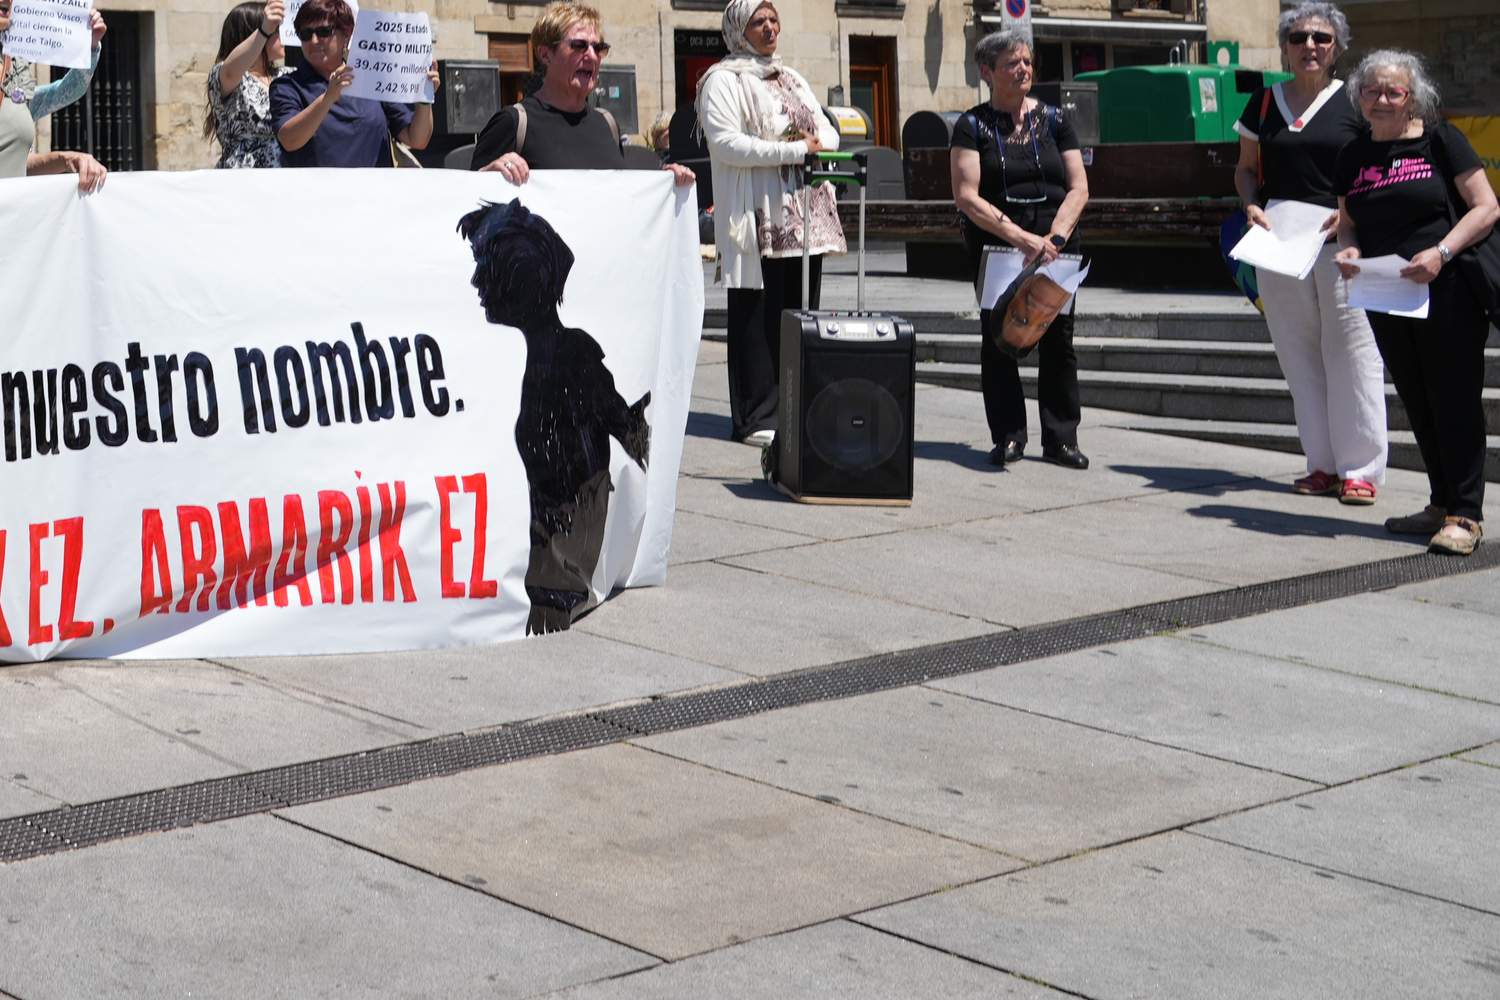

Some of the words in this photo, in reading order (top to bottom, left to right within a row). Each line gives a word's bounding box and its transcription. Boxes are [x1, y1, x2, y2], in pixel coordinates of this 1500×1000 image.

[13, 6, 55, 18] Gobierno
[56, 12, 83, 24] Vasco,
[32, 22, 63, 34] cierran
[65, 26, 72, 36] la
[374, 21, 403, 33] 2025
[26, 35, 37, 44] de
[40, 38, 65, 49] Talgo.
[358, 40, 402, 54] GASTO
[10, 46, 42, 56] 2025/10/24
[400, 63, 428, 74] millones
[374, 81, 398, 94] 2,42
[400, 83, 408, 94] %
[0, 341, 221, 463] nuestro
[234, 321, 465, 435] nombre.
[434, 472, 497, 601] EZ
